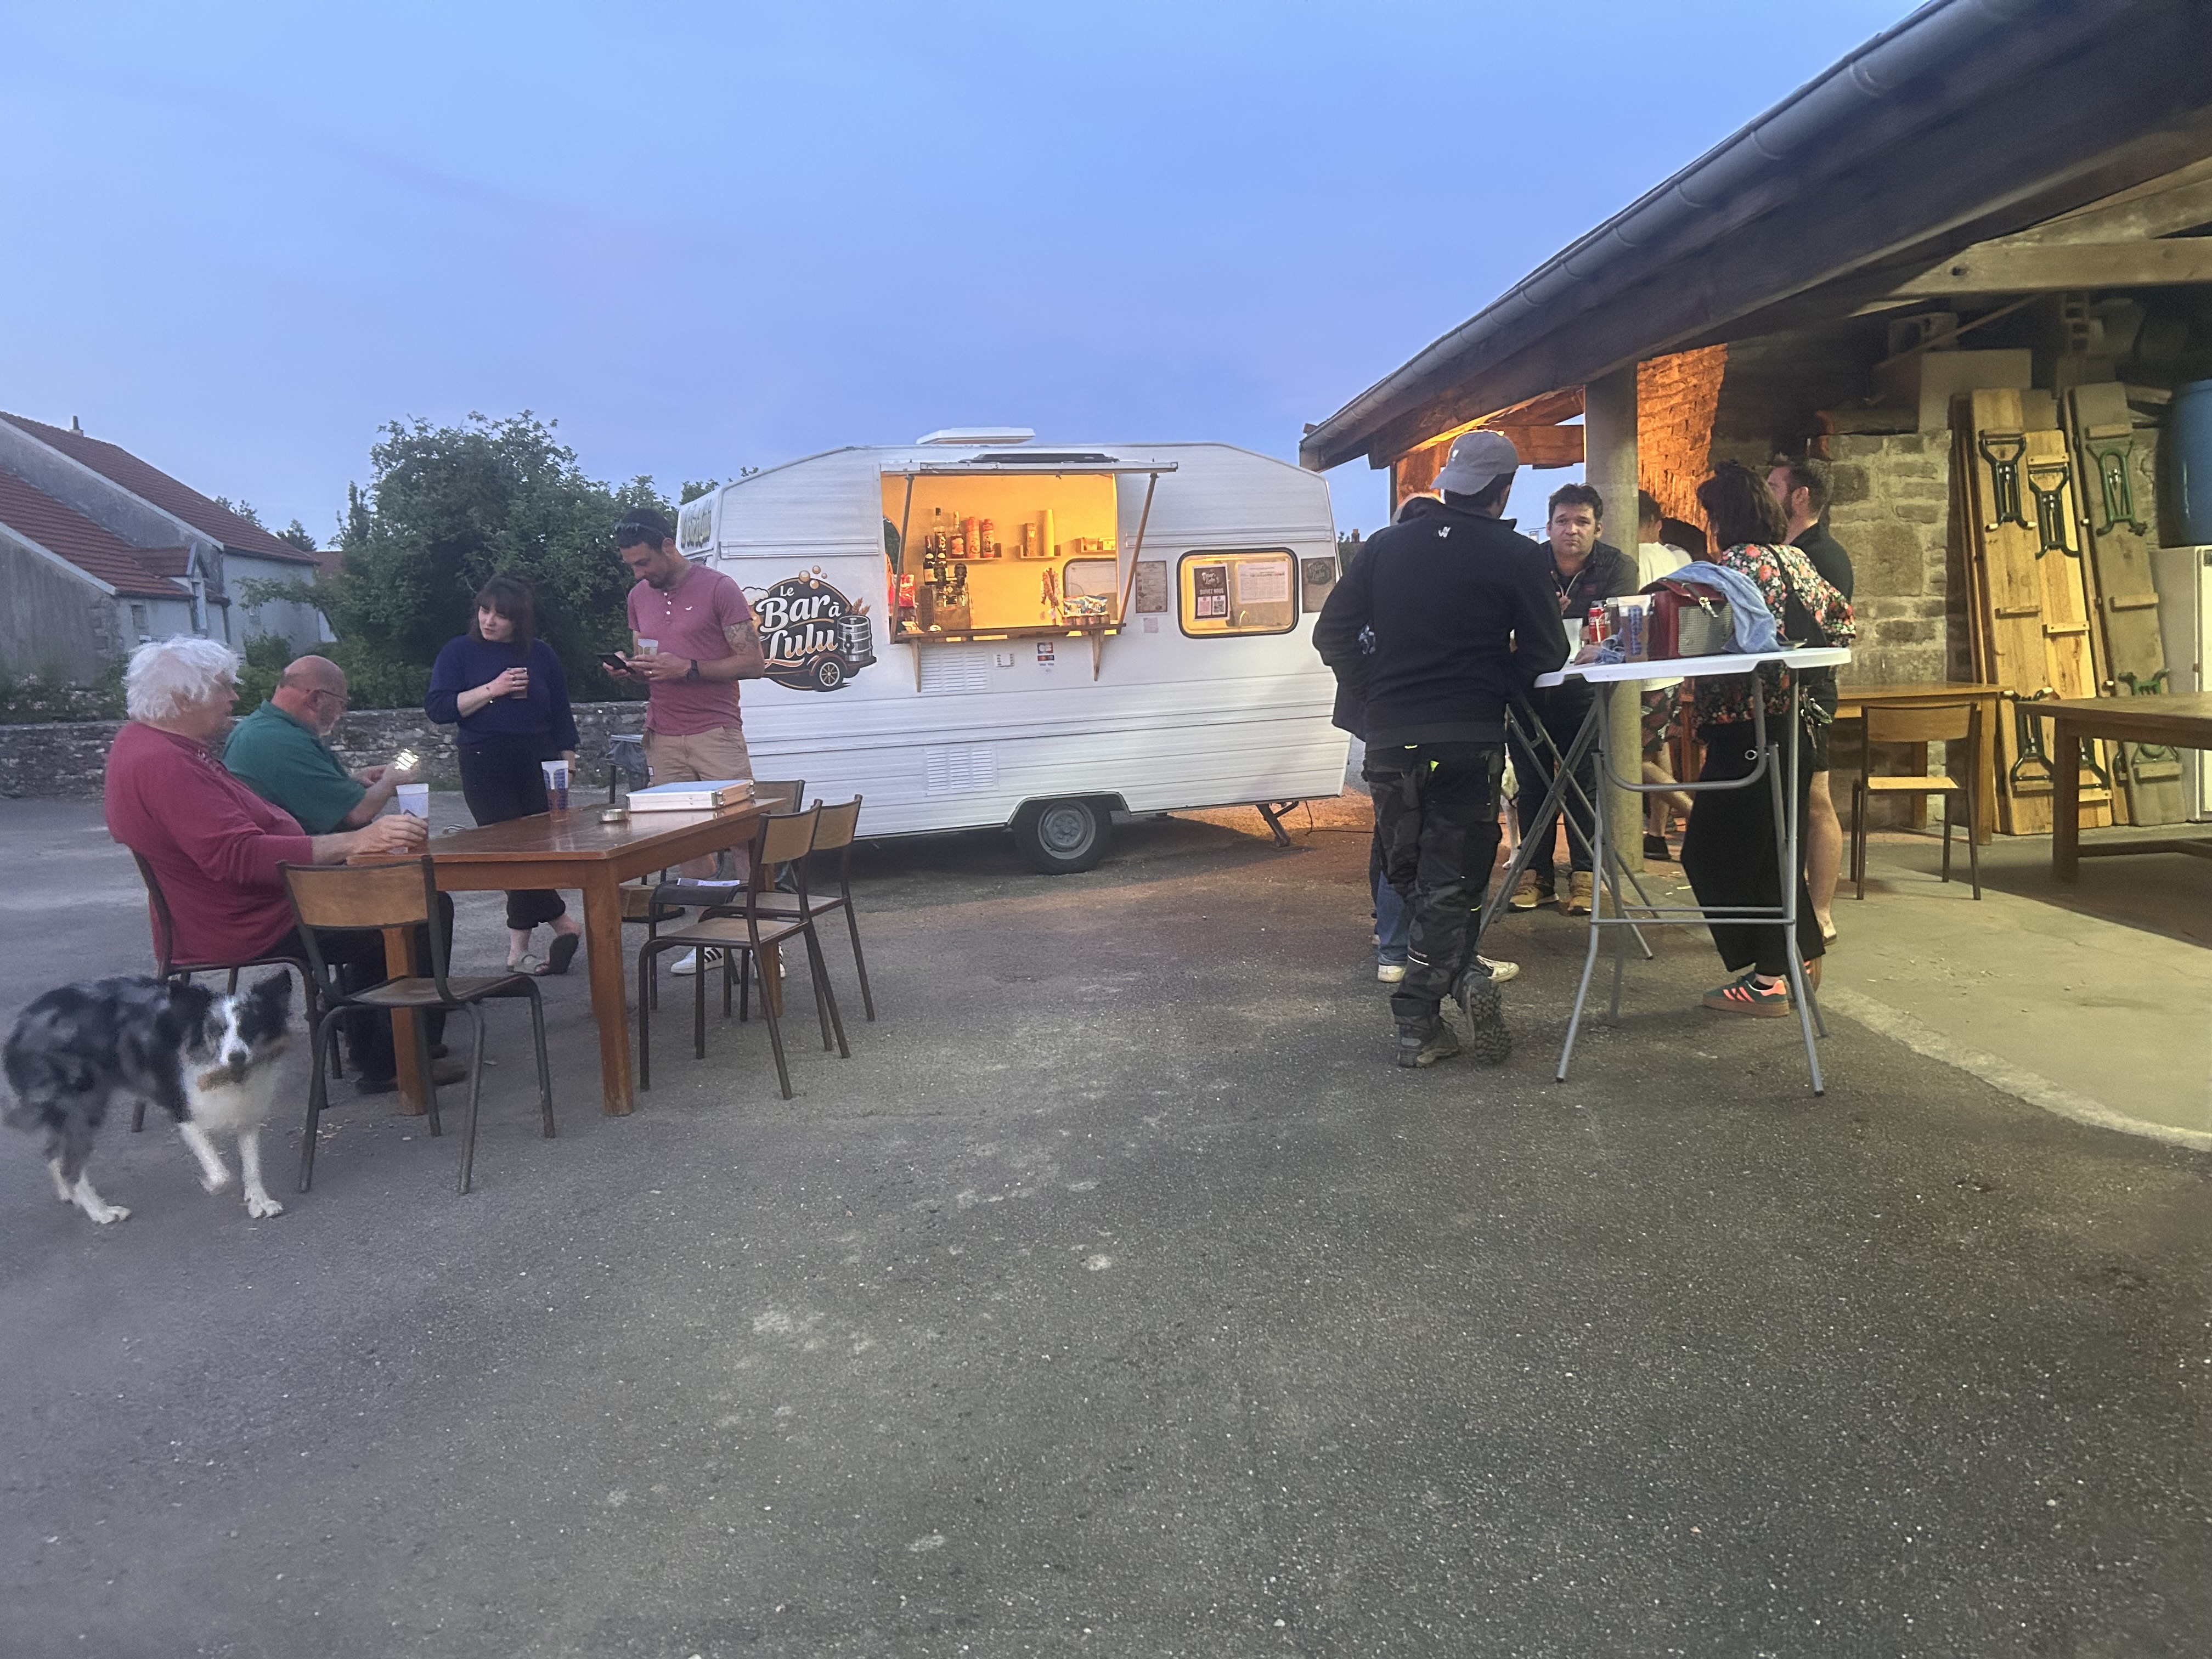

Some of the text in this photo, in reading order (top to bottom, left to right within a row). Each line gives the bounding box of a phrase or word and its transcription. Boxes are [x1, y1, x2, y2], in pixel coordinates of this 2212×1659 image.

[780, 585, 794, 596] Le
[756, 595, 842, 633] Bar à
[764, 623, 839, 668] Lulu
